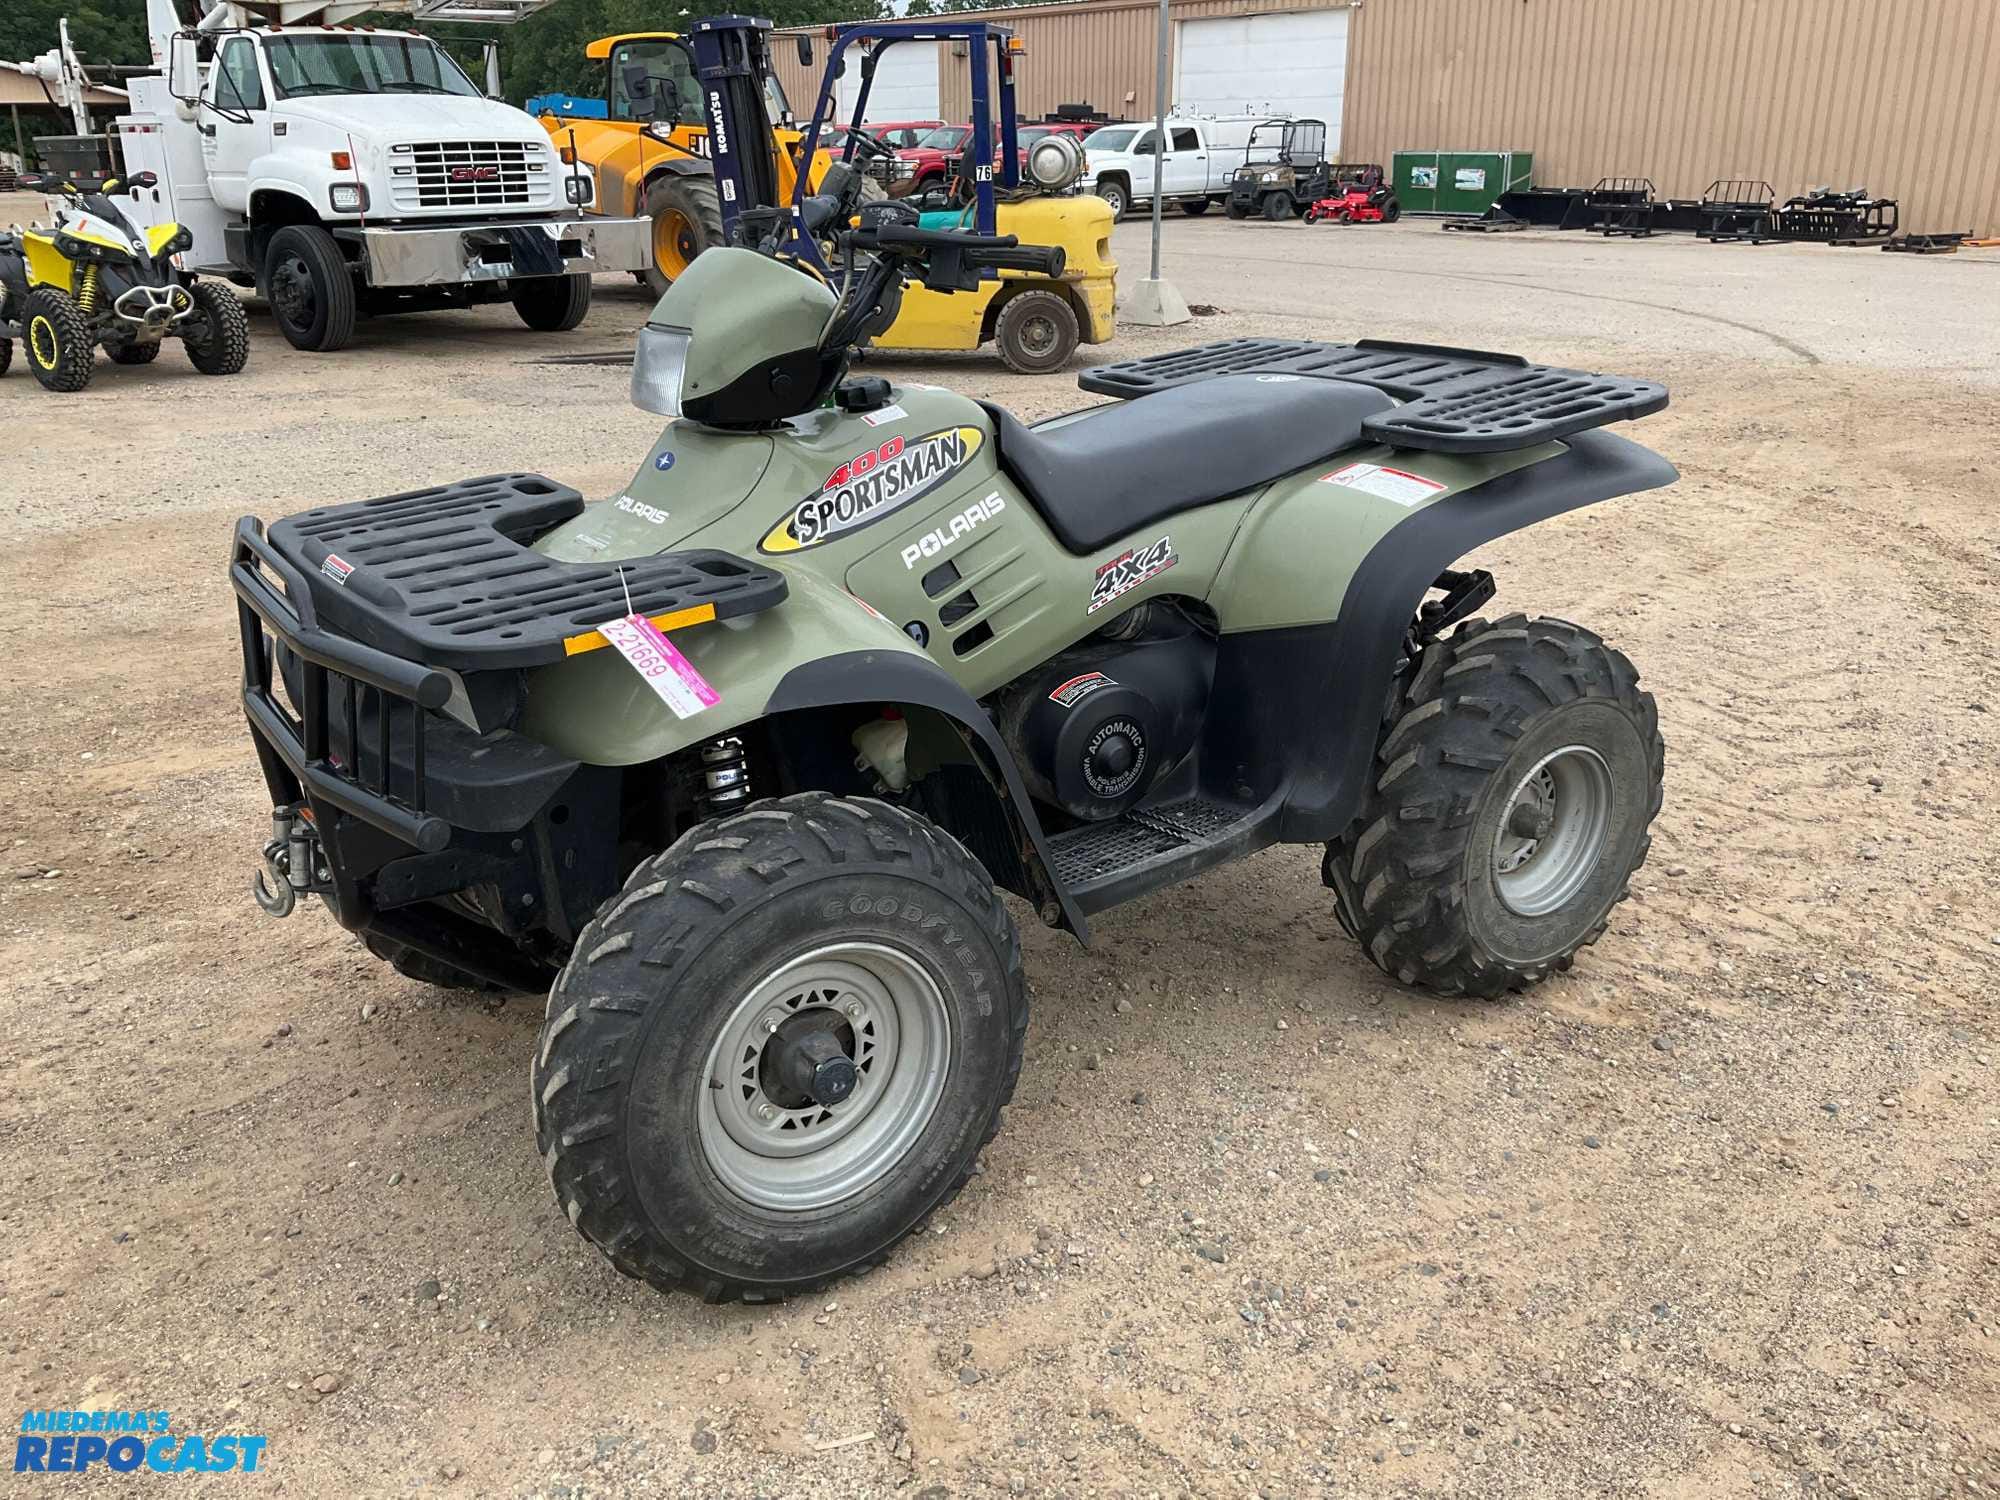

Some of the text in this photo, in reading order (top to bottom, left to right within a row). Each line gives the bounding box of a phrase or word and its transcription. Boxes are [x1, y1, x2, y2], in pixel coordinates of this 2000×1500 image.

[710, 91, 728, 154] KOMATSU
[452, 167, 497, 180] GMC
[977, 166, 991, 180] 76
[795, 428, 961, 545] SPORTSMAN
[823, 435, 905, 492] 400
[614, 495, 671, 525] POLARIS
[900, 491, 1006, 570] POLARIS
[1091, 536, 1171, 600] 4X4
[605, 623, 667, 678] 2-21669
[1088, 721, 1142, 755] AUTOMATIC
[822, 894, 993, 1017] GOODYEAR
